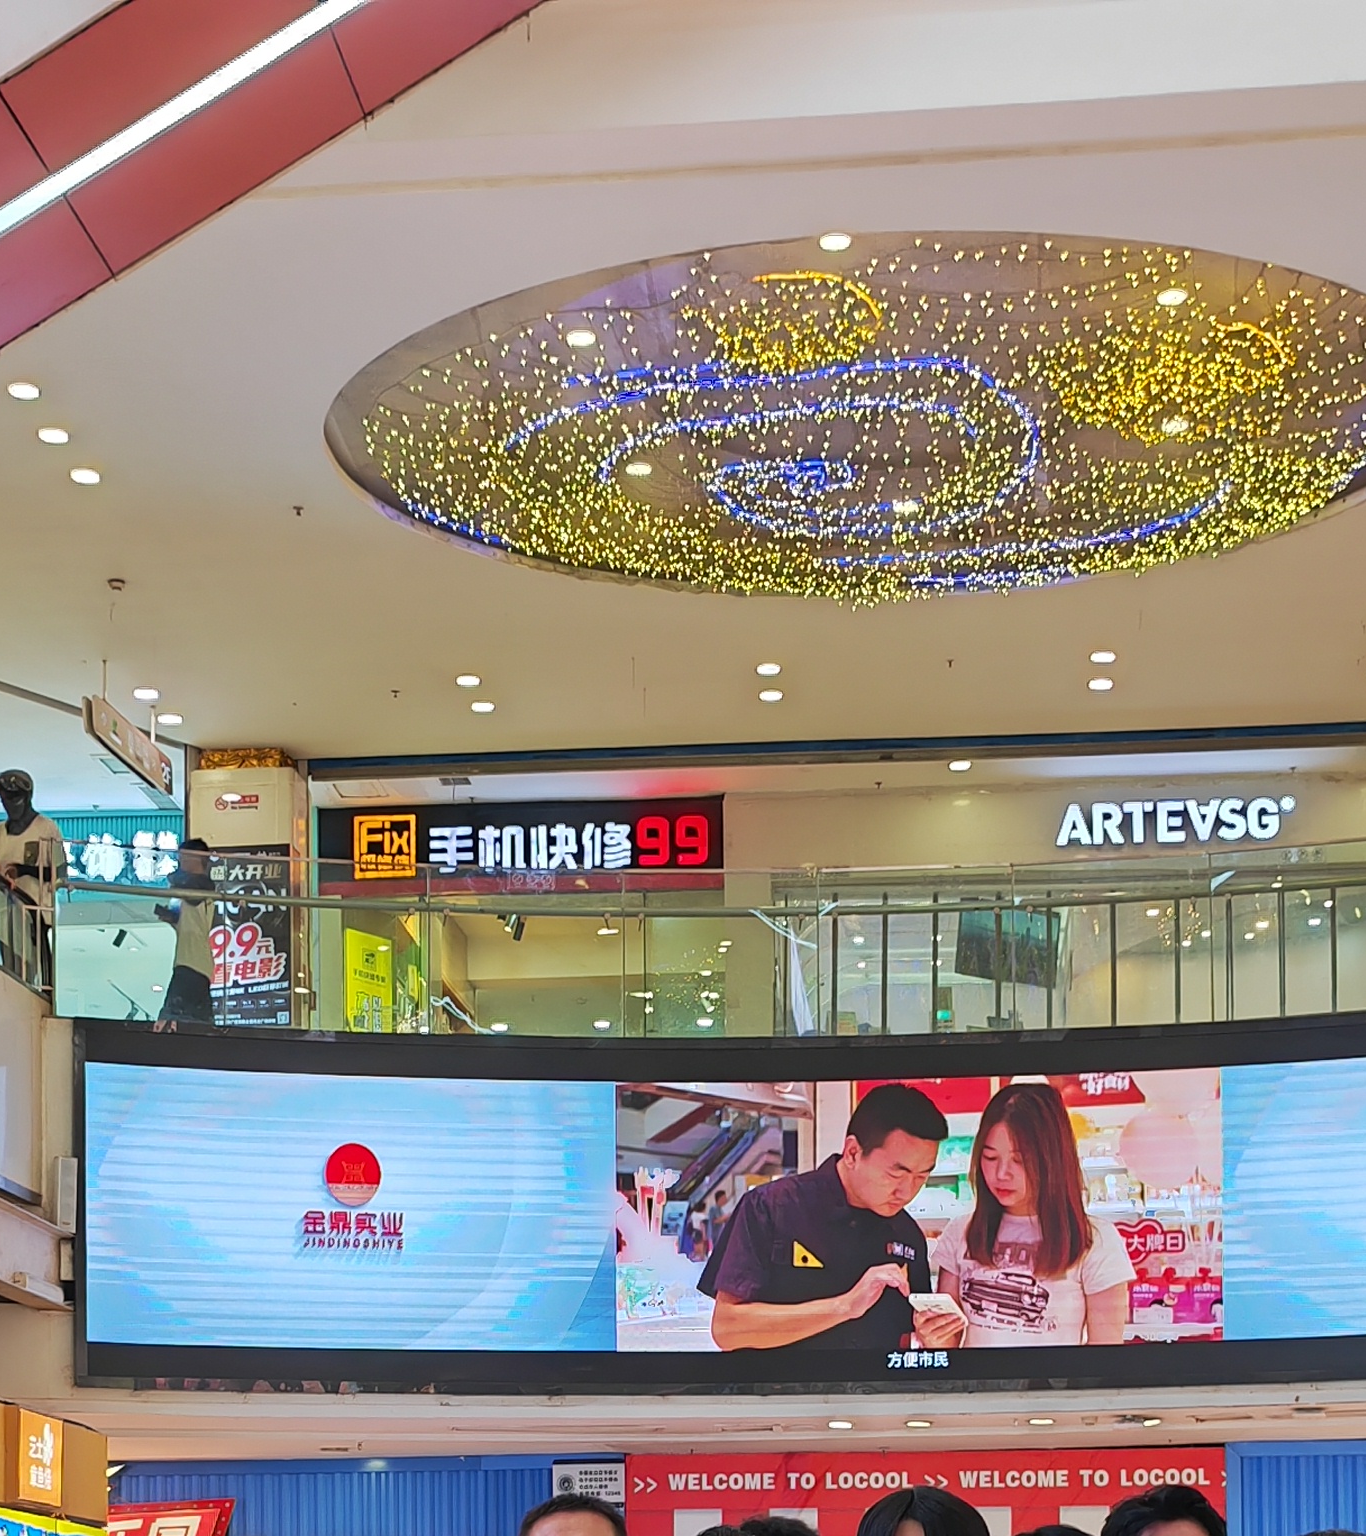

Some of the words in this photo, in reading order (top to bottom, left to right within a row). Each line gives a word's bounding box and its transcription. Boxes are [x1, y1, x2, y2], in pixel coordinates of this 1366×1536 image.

[361, 821, 410, 854] Fix
[303, 1210, 404, 1237] 金鼎实业
[887, 1351, 949, 1369] 方便市民
[668, 1472, 775, 1491] WELCOME
[787, 1472, 816, 1490] TO
[825, 1471, 914, 1489] LOCOOL
[959, 1469, 1069, 1488] WELCOME
[1079, 1469, 1109, 1487] TO
[1120, 1468, 1211, 1487] LOCOOL
